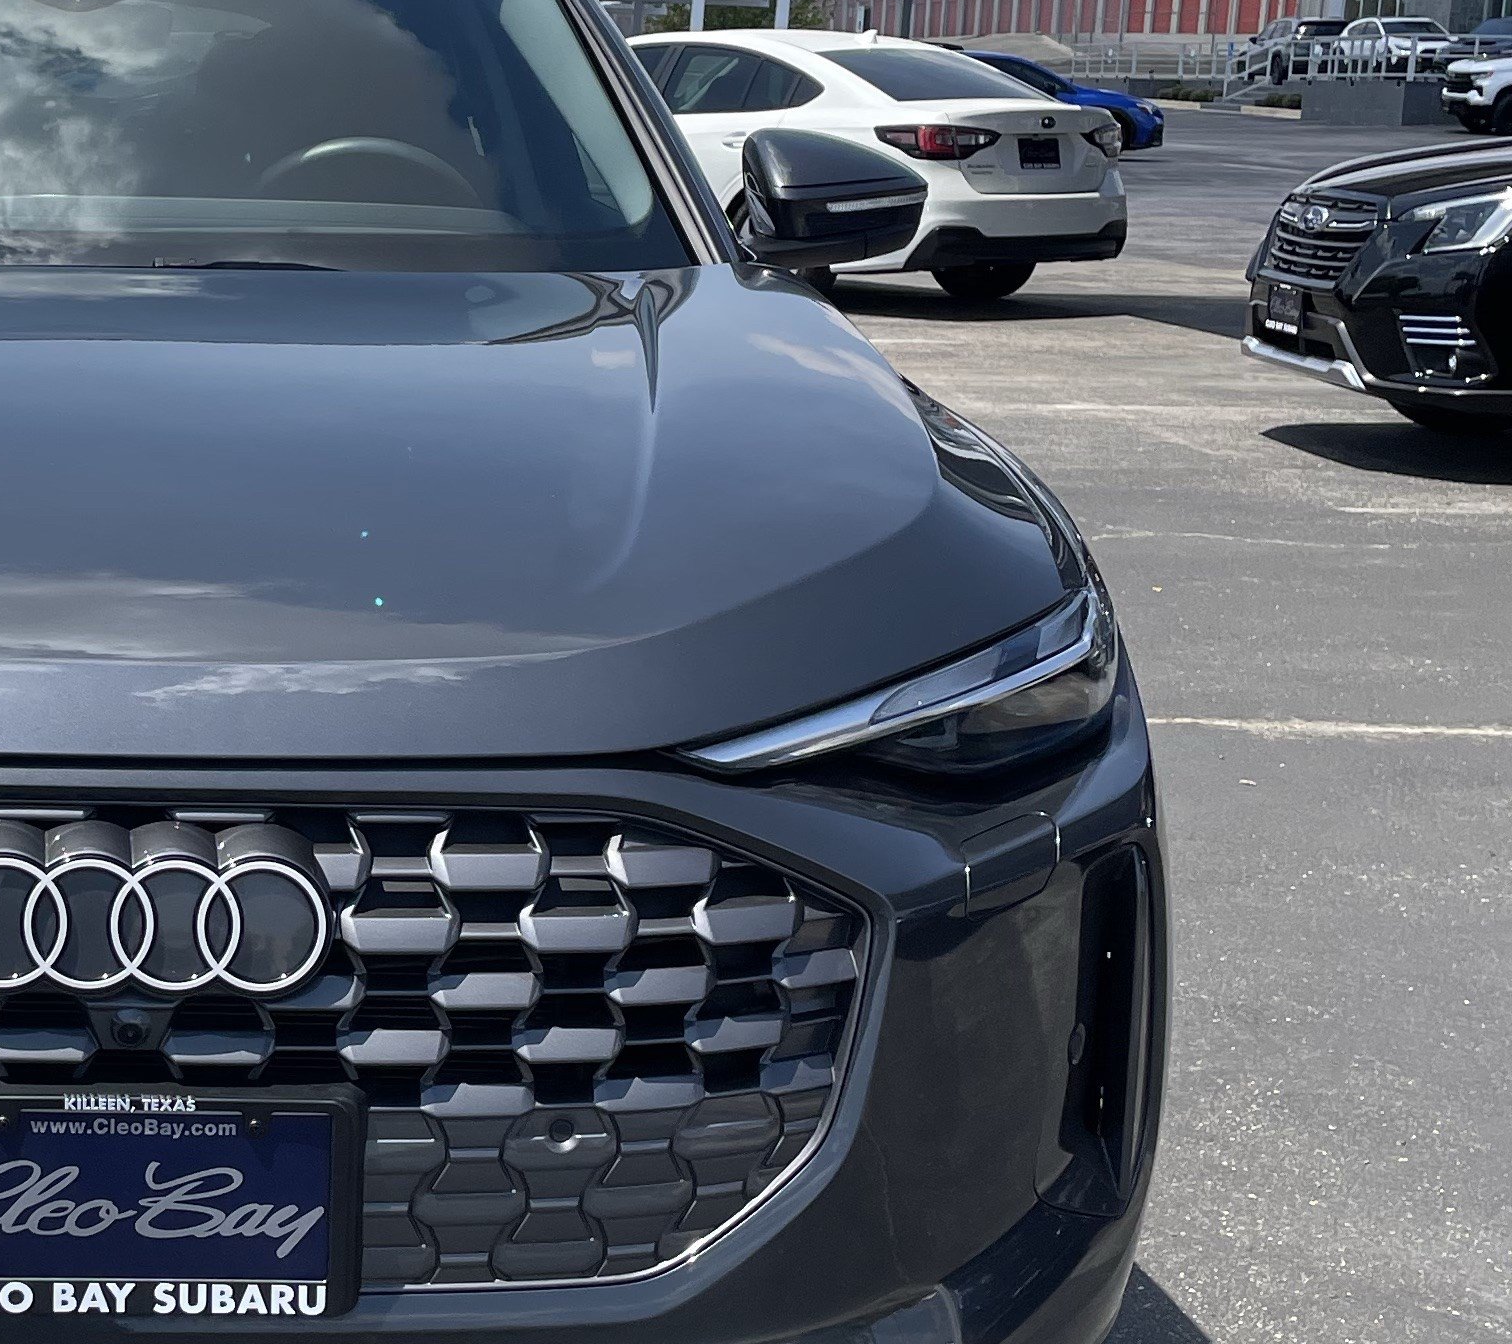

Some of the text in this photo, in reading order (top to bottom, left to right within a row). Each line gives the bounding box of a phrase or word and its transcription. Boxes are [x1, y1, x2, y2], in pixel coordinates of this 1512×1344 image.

[64, 1096, 196, 1113] KILLEEN, TEXAS
[30, 1118, 237, 1139] www.CleoBay.com
[134, 1161, 326, 1259] Bay
[52, 1282, 136, 1314] BAY
[152, 1283, 327, 1316] SUBARU
